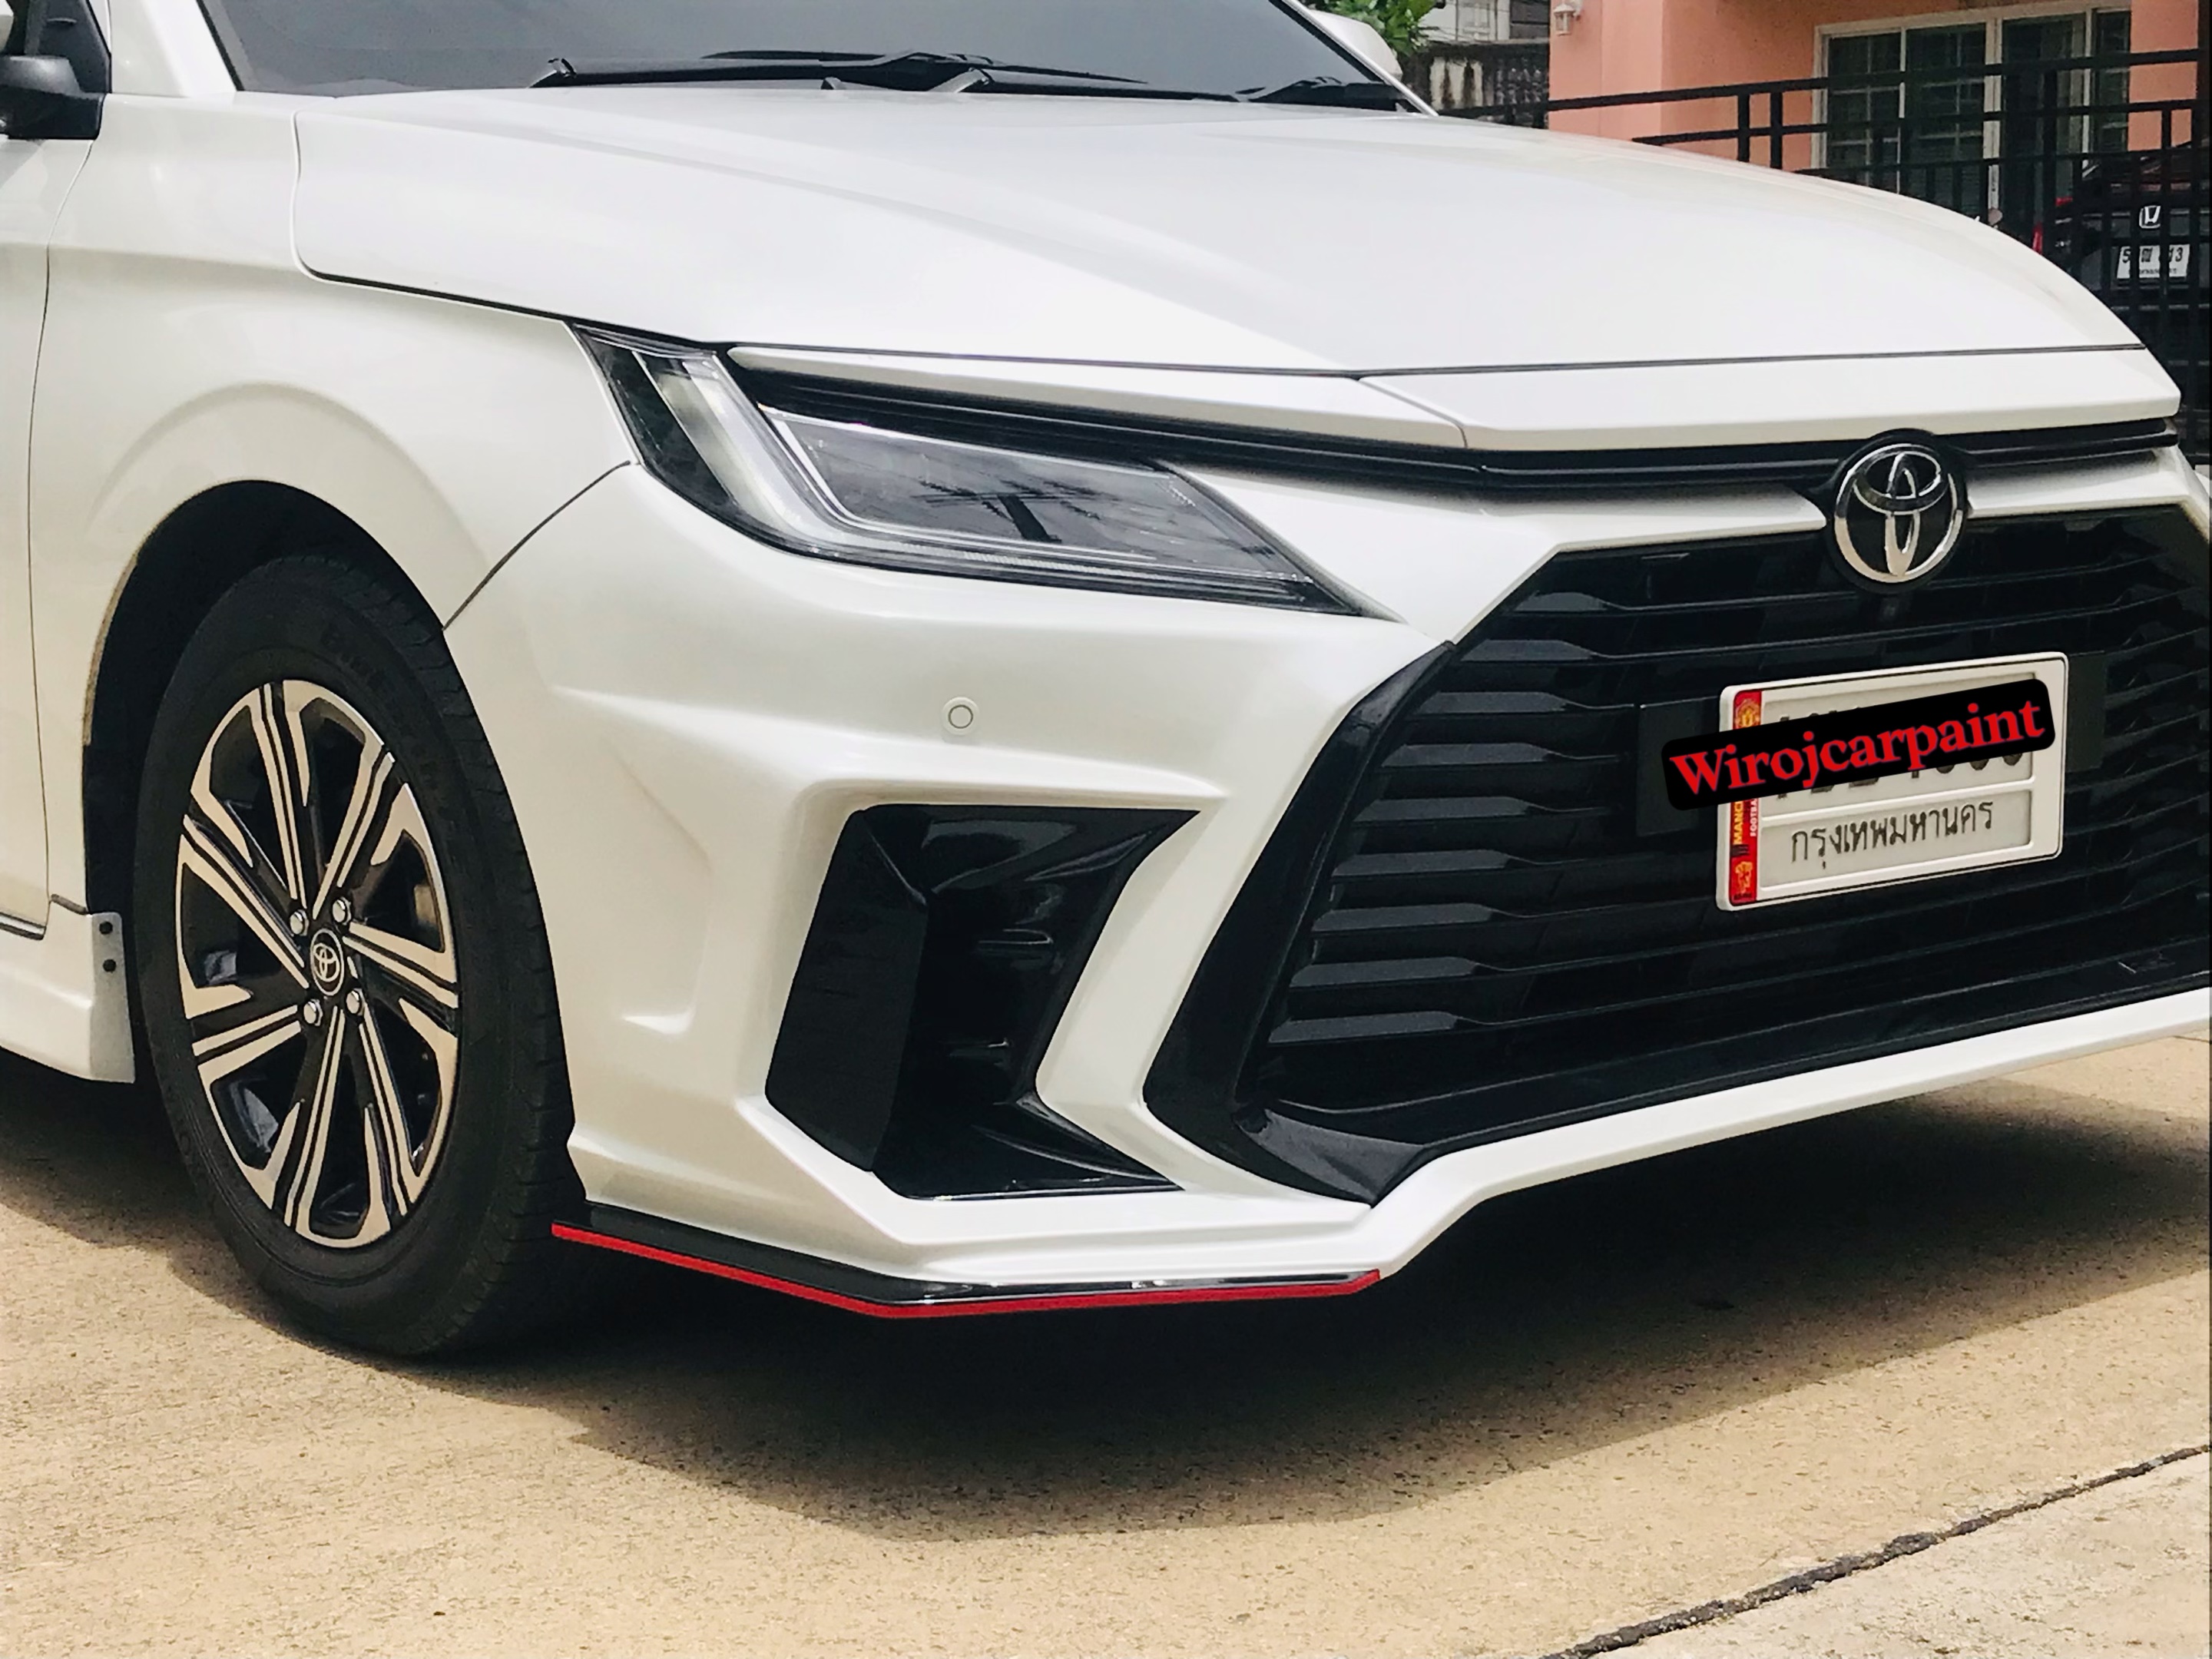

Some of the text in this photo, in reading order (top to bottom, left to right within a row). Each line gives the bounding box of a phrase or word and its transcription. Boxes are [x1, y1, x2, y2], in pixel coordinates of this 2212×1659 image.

[1749, 797, 1758, 836] FOOTBA
[1790, 800, 1994, 869] กรุงเทพมหานคร
